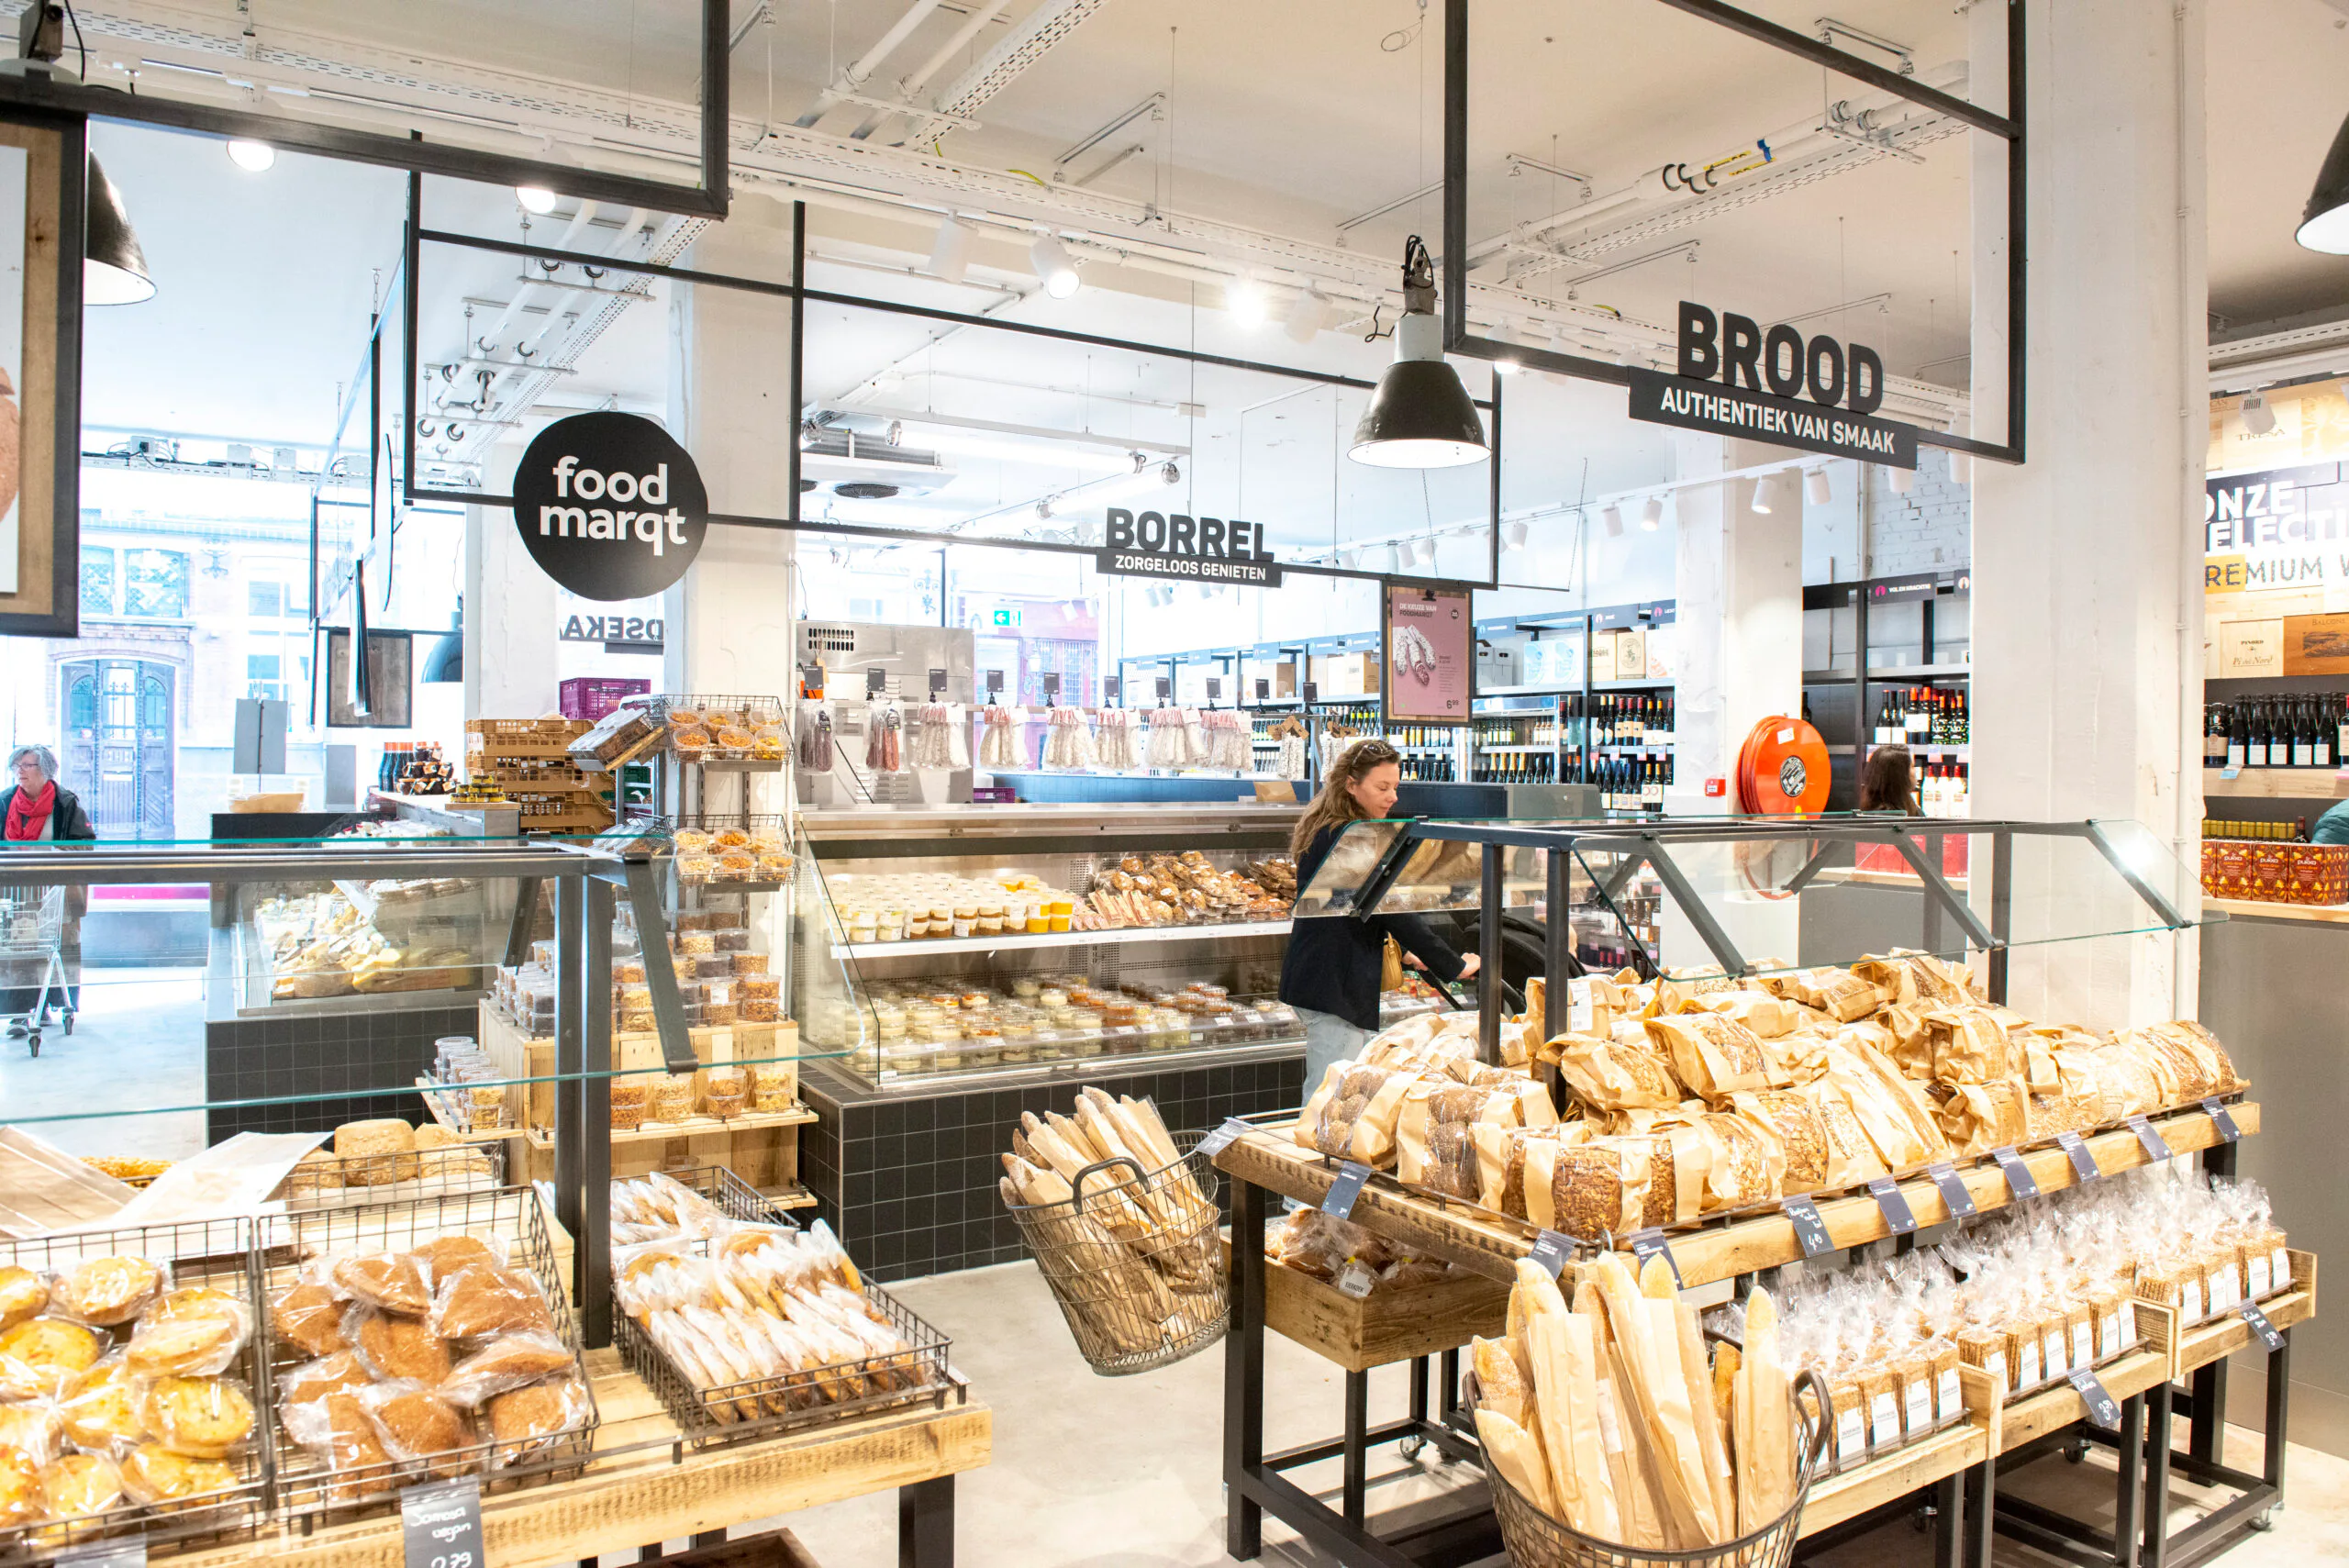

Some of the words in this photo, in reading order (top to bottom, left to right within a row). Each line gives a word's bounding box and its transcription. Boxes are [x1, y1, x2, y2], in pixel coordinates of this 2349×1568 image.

[1678, 300, 1883, 415] BROOD
[1660, 386, 1788, 434] AUTHENTIEK
[1789, 411, 1829, 441] VAN
[1832, 420, 1896, 455] SMAAK
[553, 455, 668, 505] food
[540, 506, 688, 557] marqt
[1106, 507, 1275, 561] BORREL
[1115, 554, 1198, 574] ZORGELOOS
[1201, 562, 1266, 581] GENIETEN
[2205, 556, 2323, 587] REMIUM
